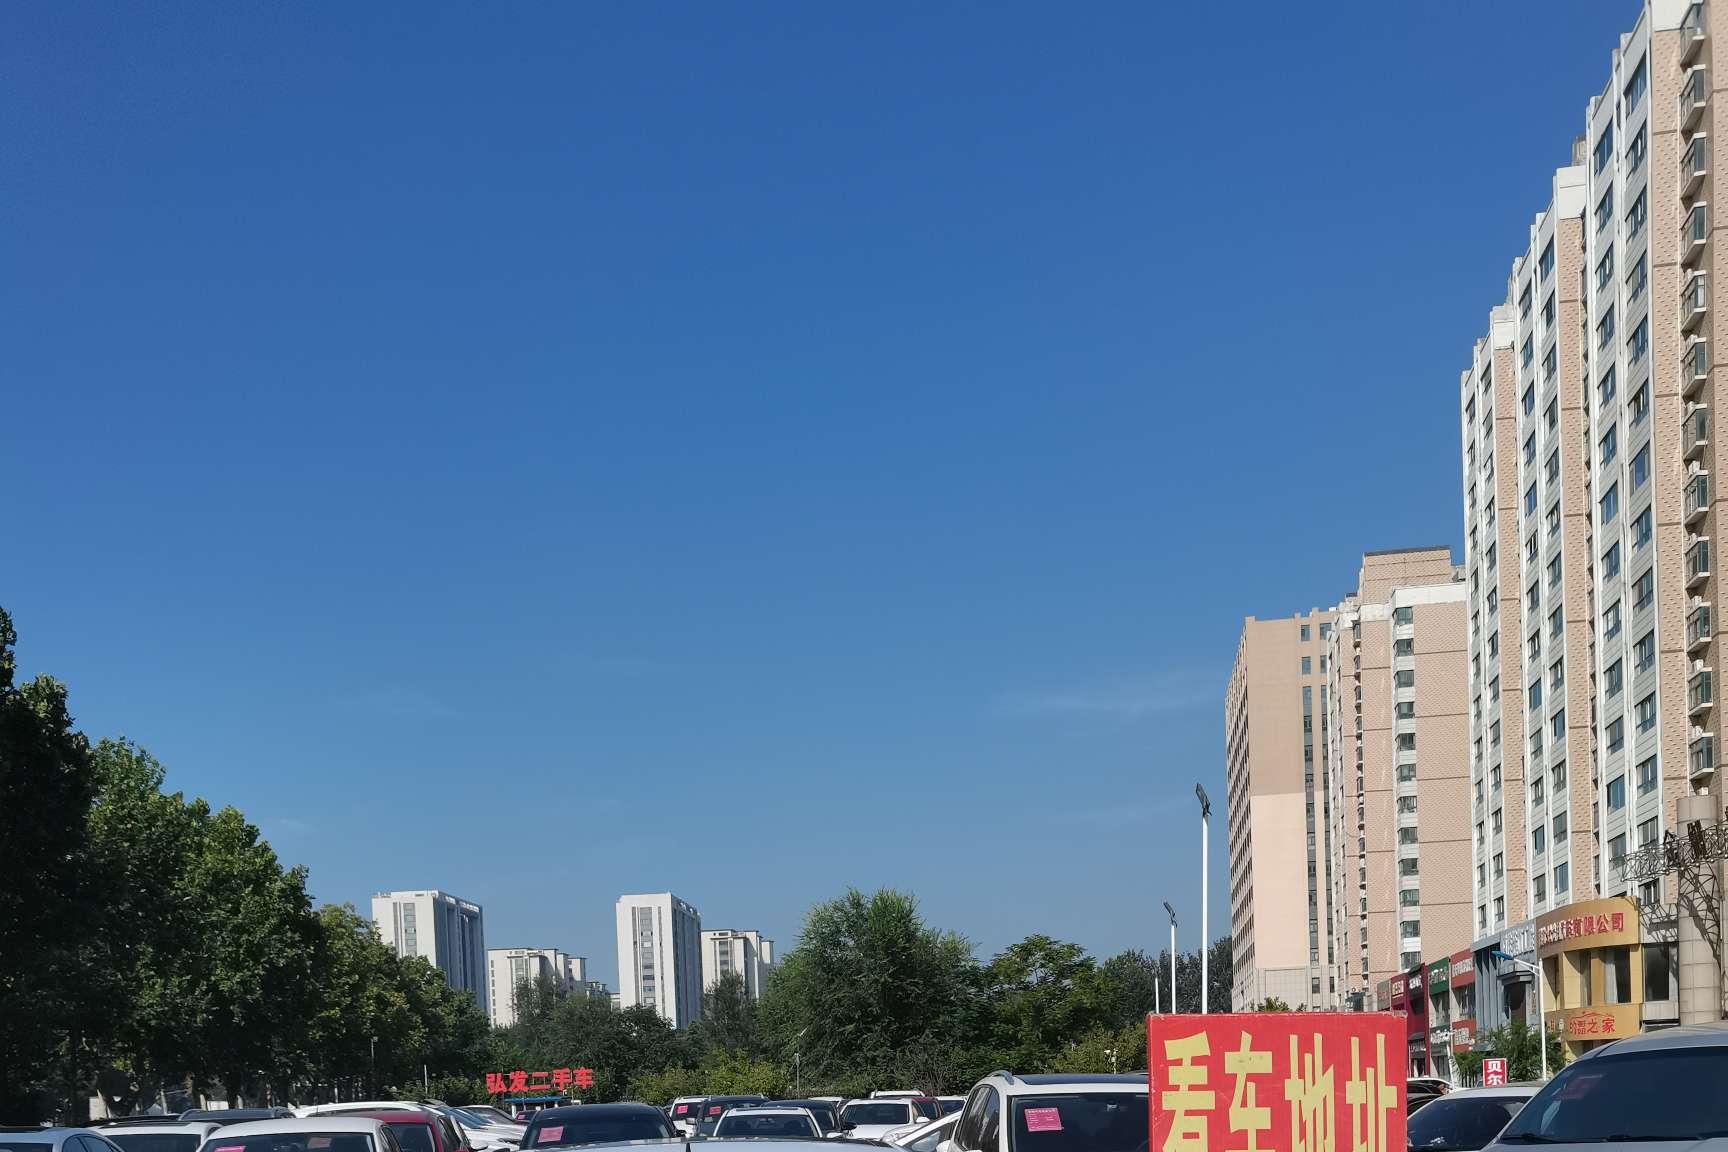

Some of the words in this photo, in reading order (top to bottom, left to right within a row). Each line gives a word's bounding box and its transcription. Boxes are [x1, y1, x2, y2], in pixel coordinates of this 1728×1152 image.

[485, 1067, 594, 1094] 弘发二手车
